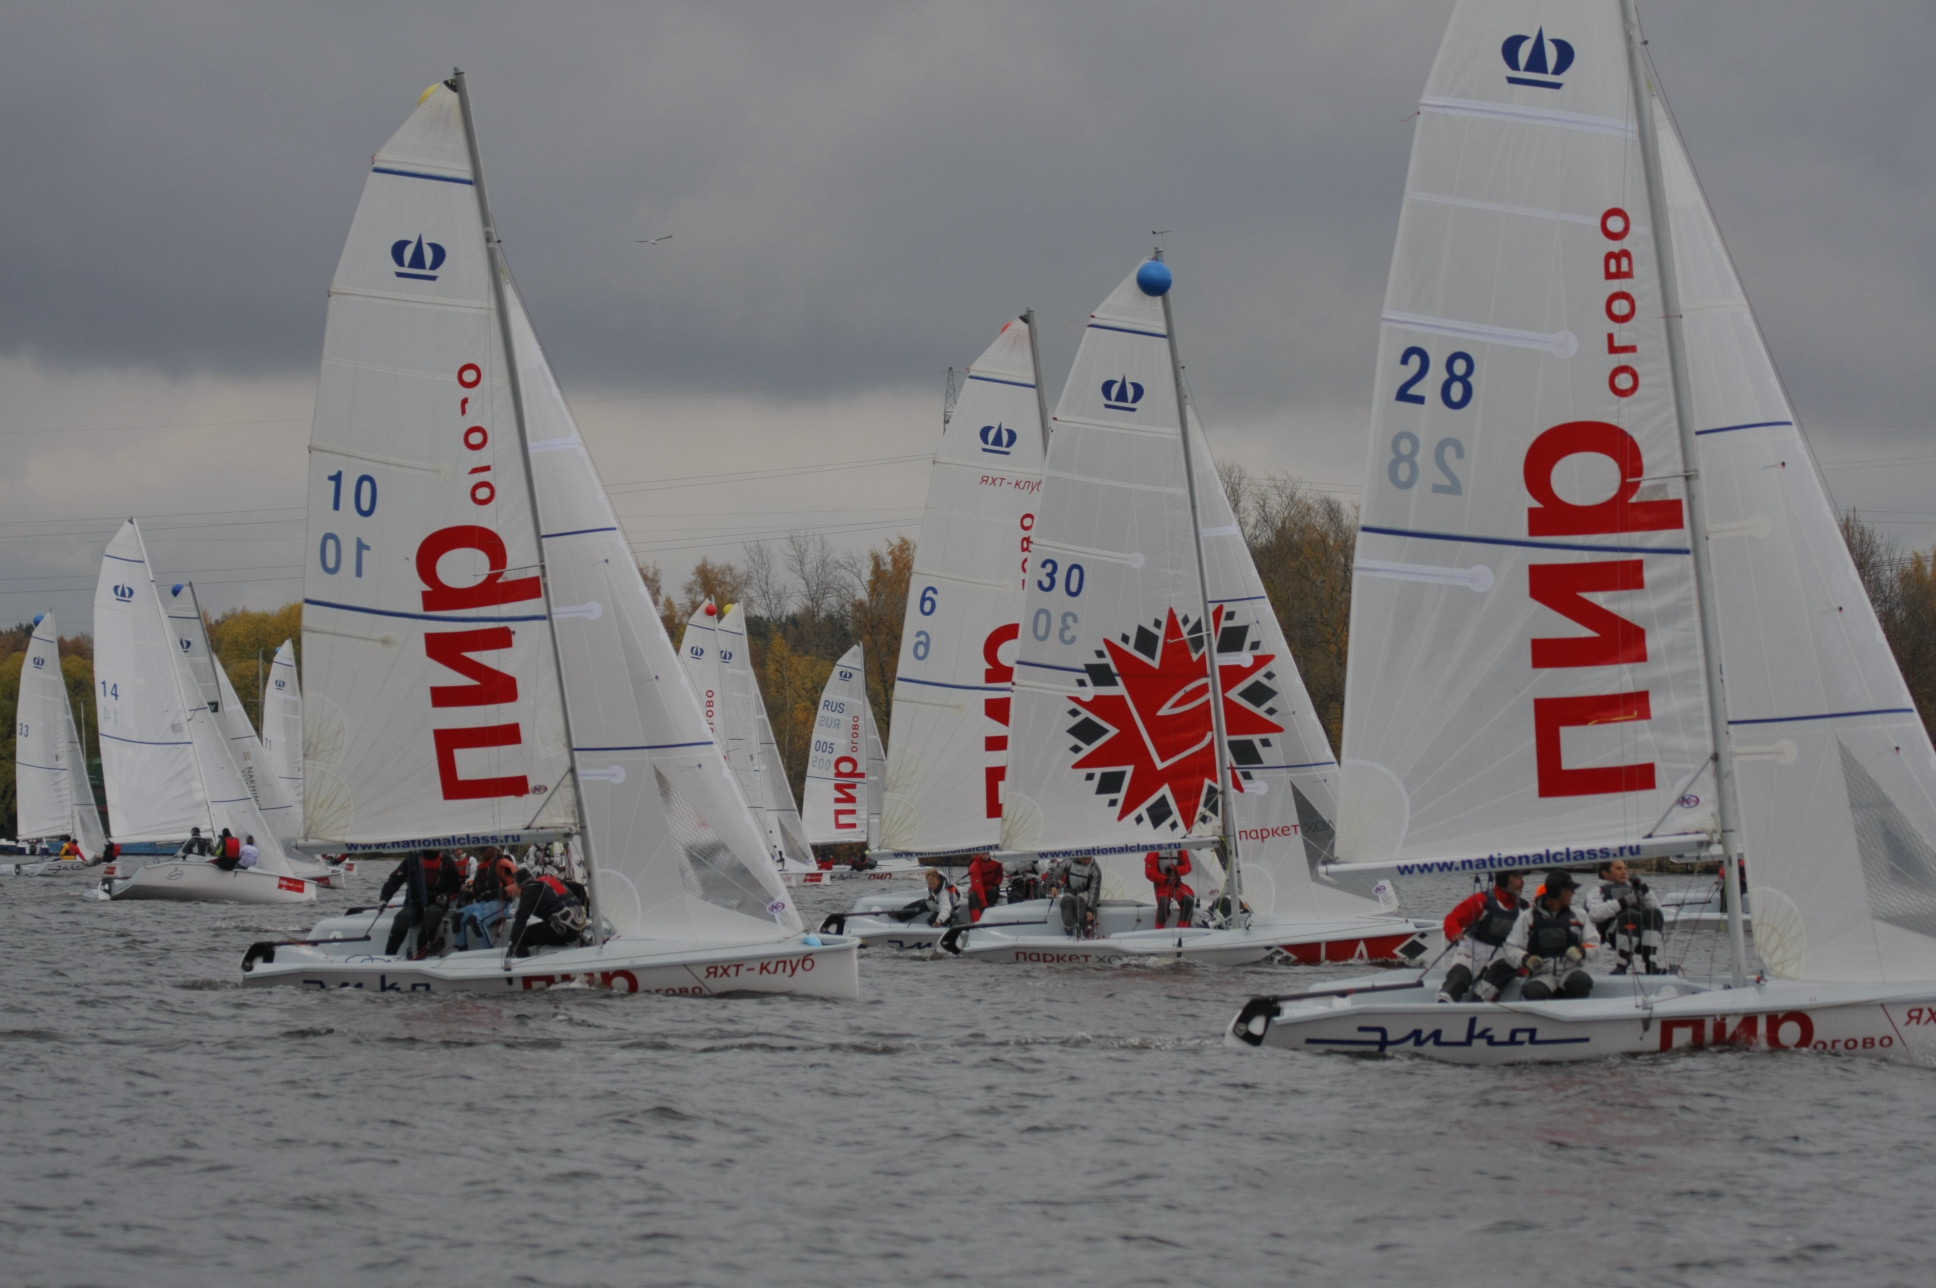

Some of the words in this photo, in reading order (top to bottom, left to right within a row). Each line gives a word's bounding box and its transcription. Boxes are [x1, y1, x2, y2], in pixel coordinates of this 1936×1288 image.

[1395, 346, 1475, 410] 28
[327, 470, 378, 517] 10
[1037, 558, 1085, 598] 30
[919, 586, 938, 616] 6
[101, 680, 119, 700] 14
[822, 700, 845, 714] RUS
[814, 740, 834, 754] 005
[346, 834, 521, 851] www.nationalclass.ru
[1238, 824, 1300, 843] паркет
[1038, 841, 1181, 859] www.nationalclass.ru
[1397, 842, 1641, 876] www.nationalclass.ru
